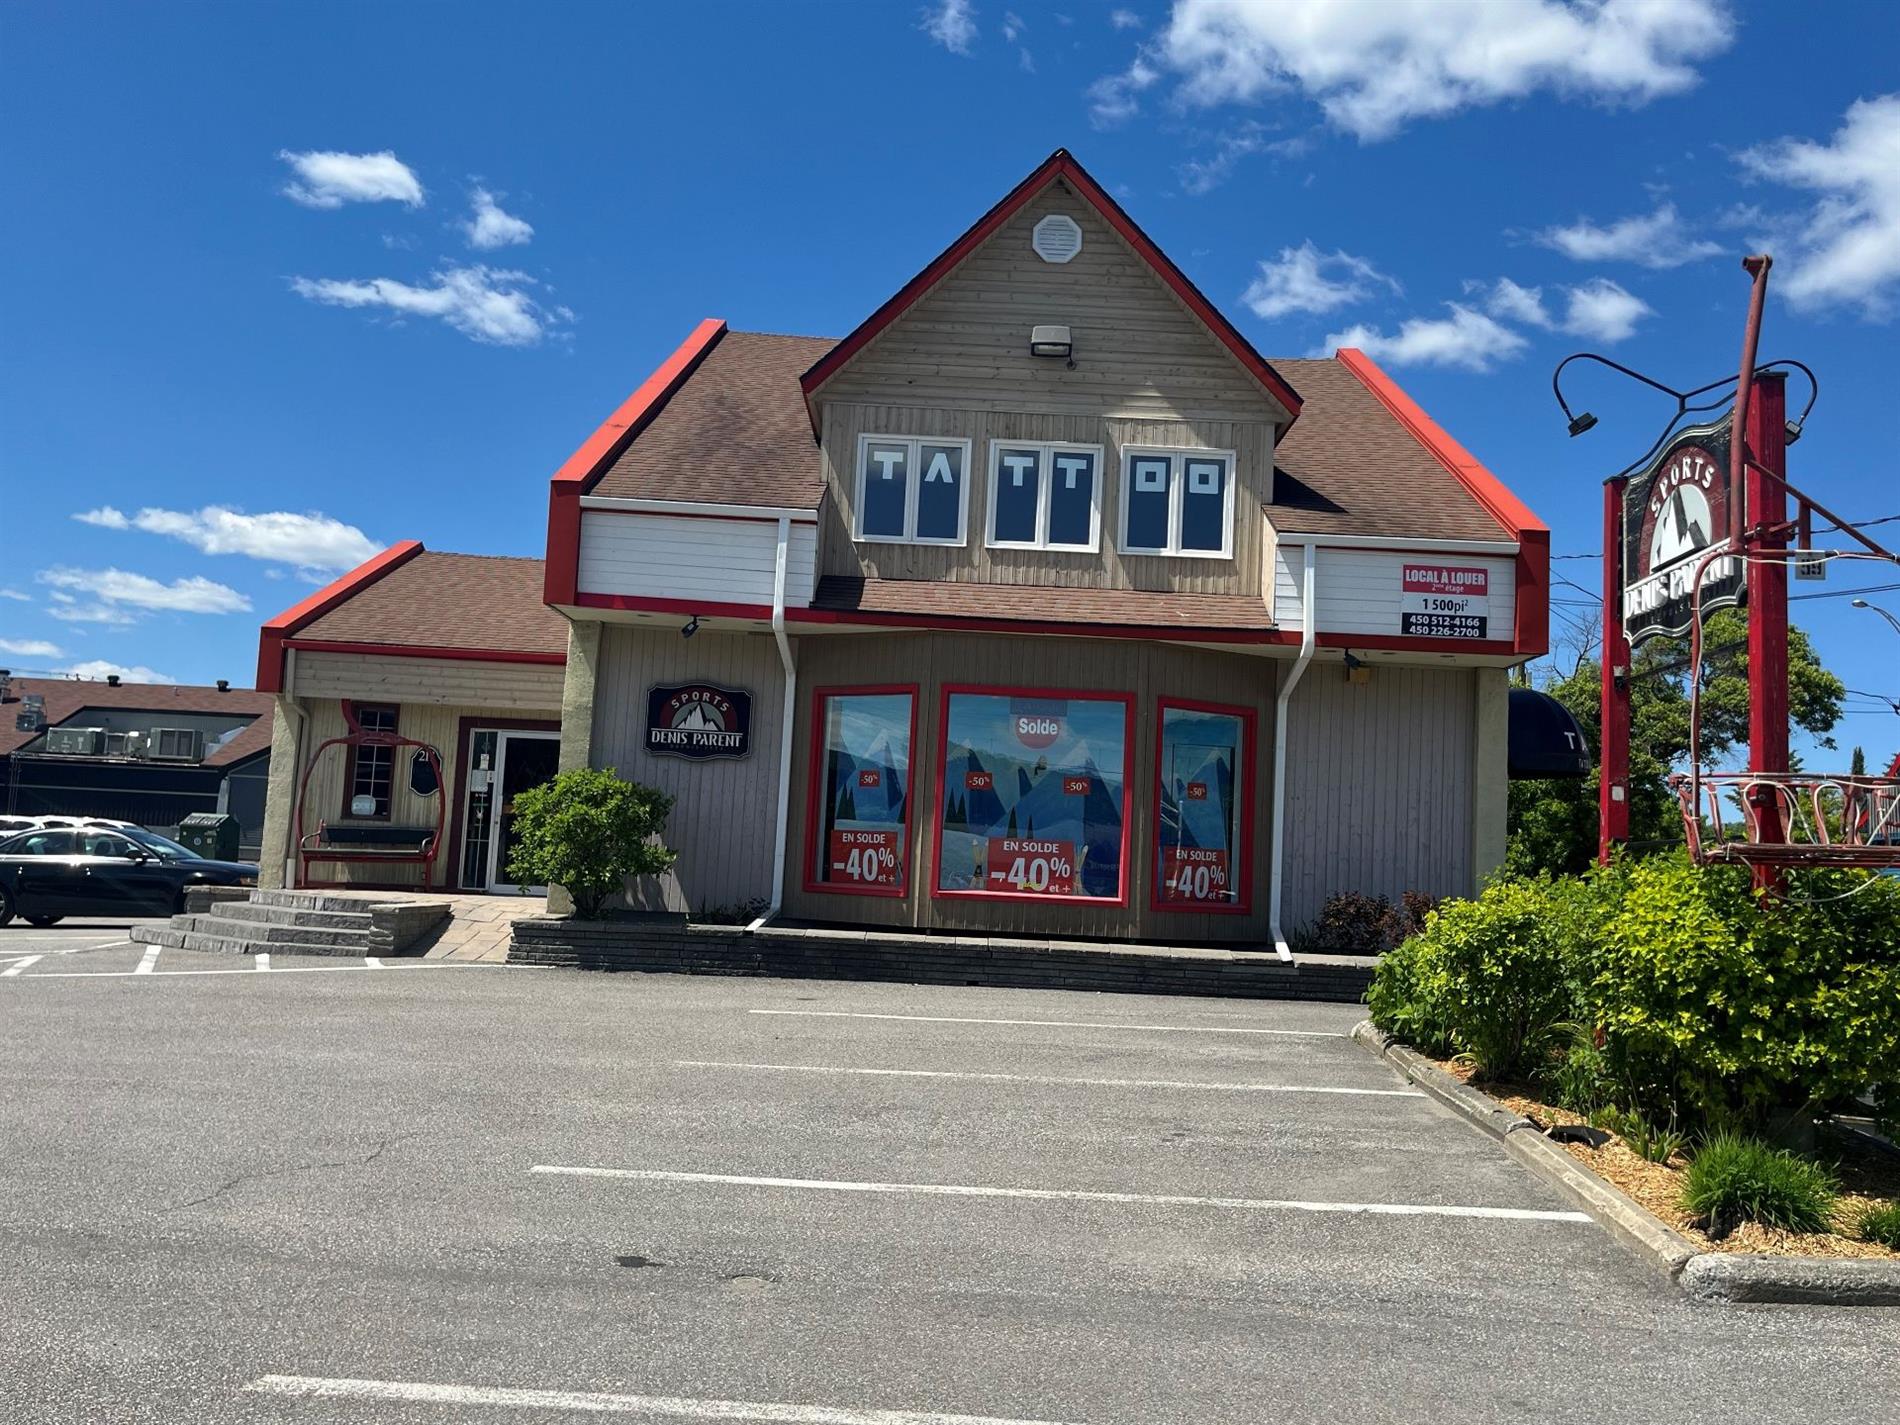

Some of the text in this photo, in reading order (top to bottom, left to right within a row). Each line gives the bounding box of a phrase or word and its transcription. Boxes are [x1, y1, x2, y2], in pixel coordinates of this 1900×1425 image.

[873, 451, 1219, 495] TATTOO
[1651, 456, 1715, 518] SPORTS
[1405, 569, 1485, 586] LOCAL À LOUER
[1445, 584, 1465, 594] étage
[1625, 575, 1669, 620] DENIS
[1410, 615, 1480, 627] 450 512-4166
[1409, 626, 1480, 637] 450 226-2700
[671, 691, 730, 712] SPORTS
[1019, 718, 1058, 735] Solde
[651, 730, 743, 747] DENIS PARENT
[842, 833, 886, 844] EN SOLDE
[1003, 841, 1060, 853] EN SOLDE
[1176, 850, 1217, 861] EN SOLDE
[833, 847, 894, 882] -40%
[991, 857, 1071, 891] -40%
[1166, 865, 1225, 899] -40%
